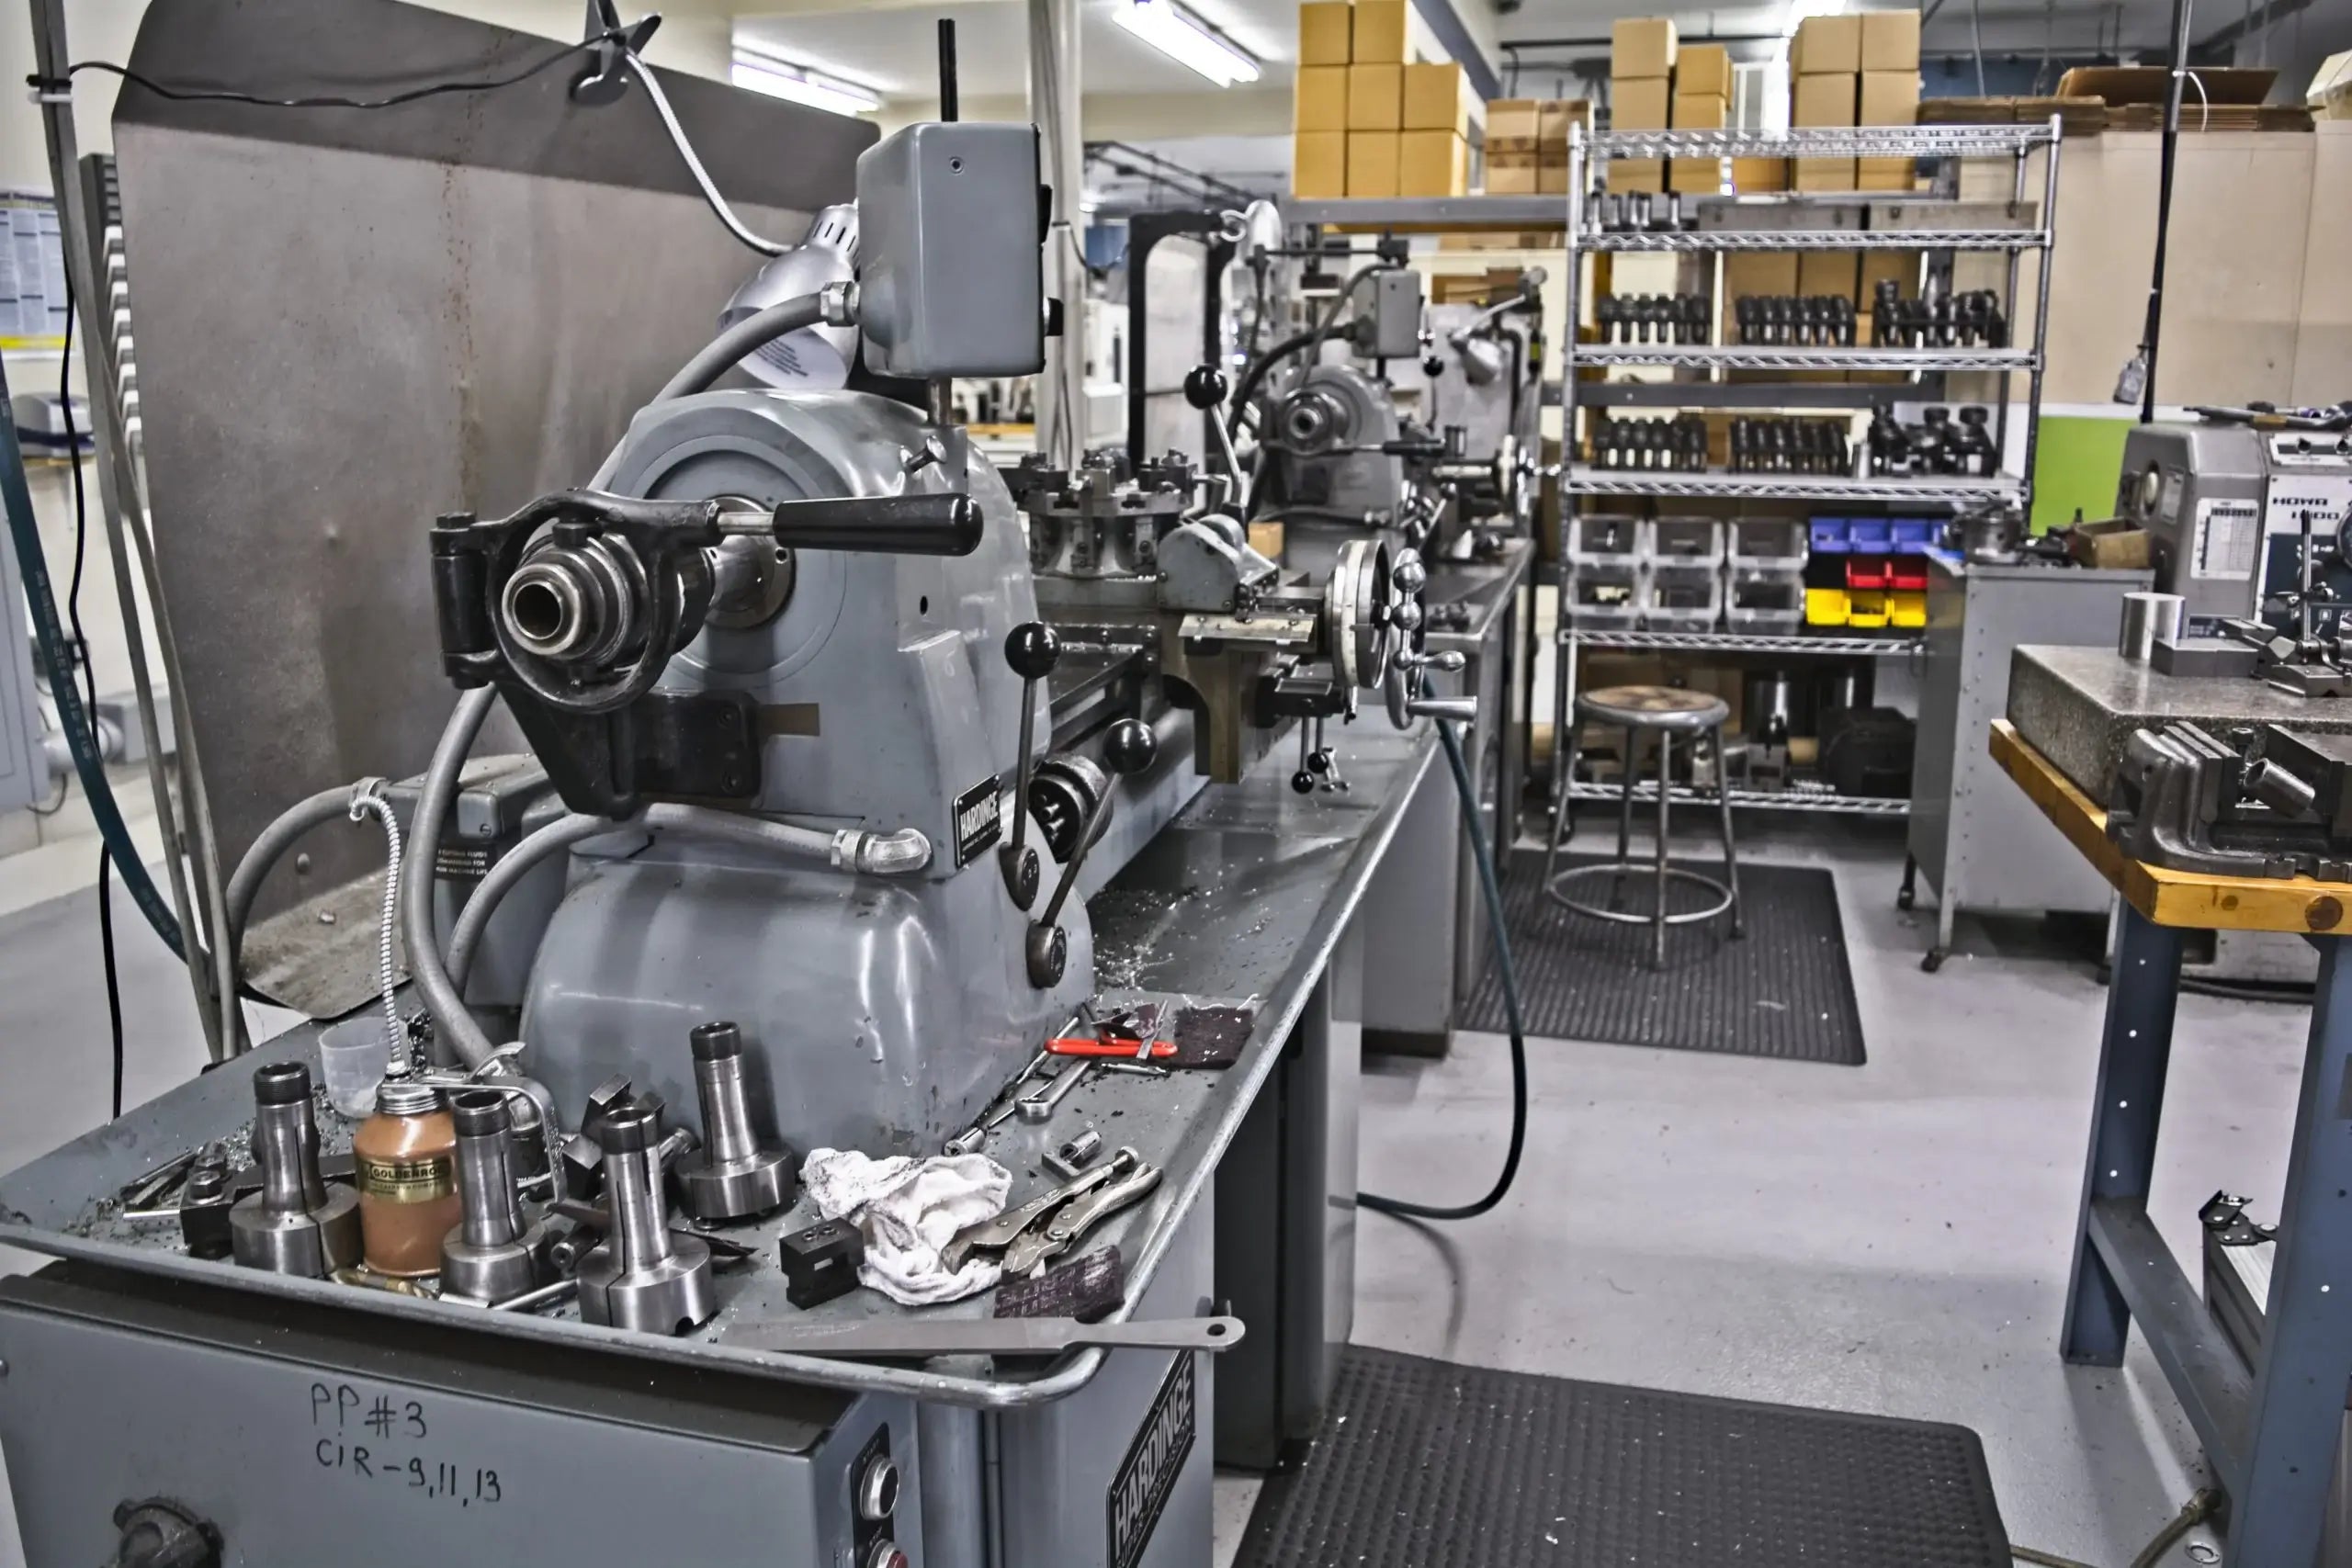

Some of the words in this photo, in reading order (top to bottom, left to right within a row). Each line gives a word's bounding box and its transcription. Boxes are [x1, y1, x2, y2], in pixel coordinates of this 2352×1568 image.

[2291, 511, 2340, 520] 100
[960, 791, 999, 841] HARDINGE
[1115, 1359, 1192, 1560] HARDINGE
